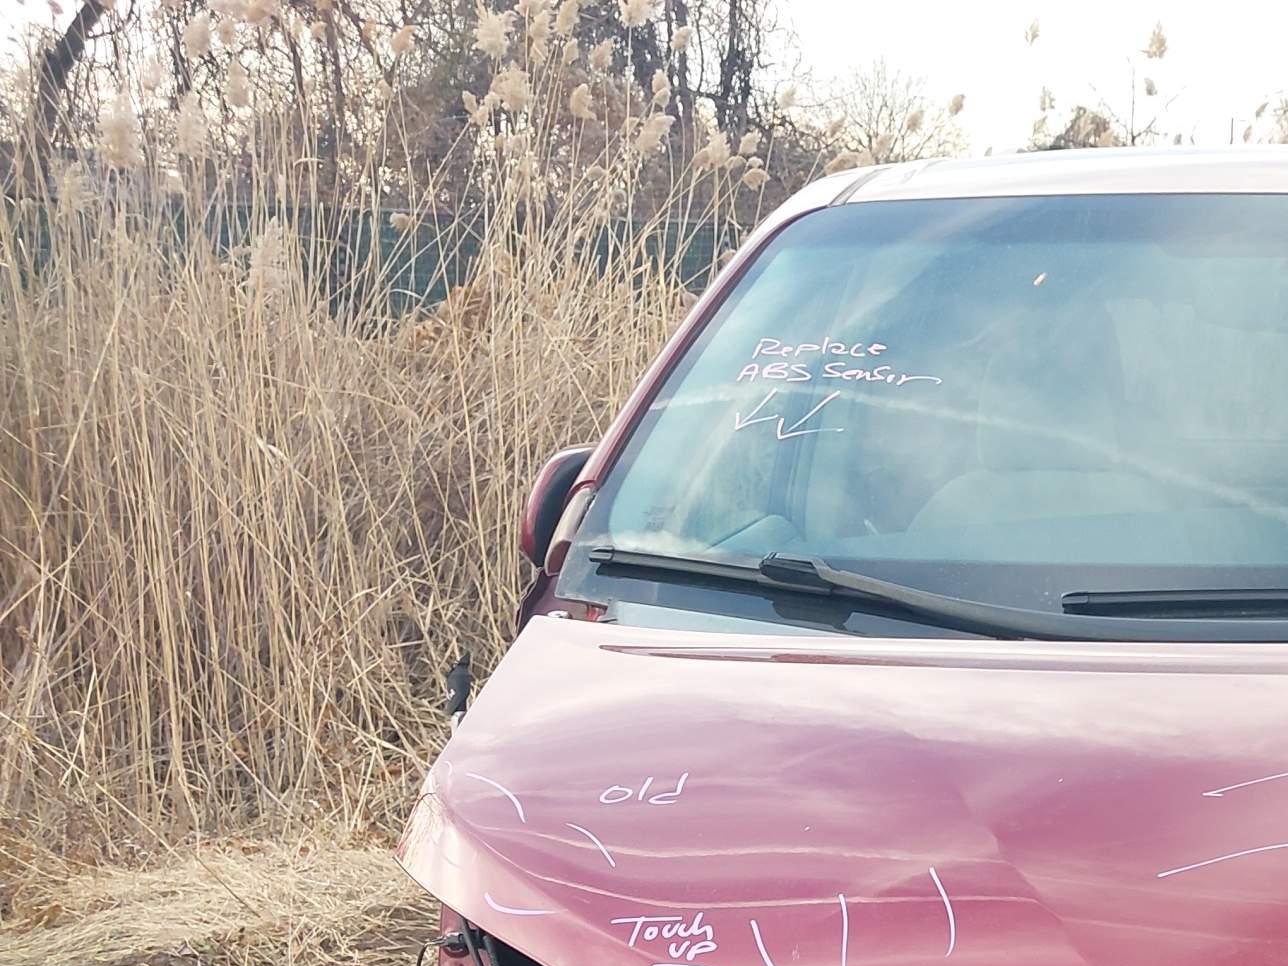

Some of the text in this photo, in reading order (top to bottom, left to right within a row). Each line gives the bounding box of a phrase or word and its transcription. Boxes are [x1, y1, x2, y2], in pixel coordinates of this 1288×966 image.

[736, 363, 812, 382] ABS
[599, 772, 689, 805] old
[610, 910, 715, 948] Touch
